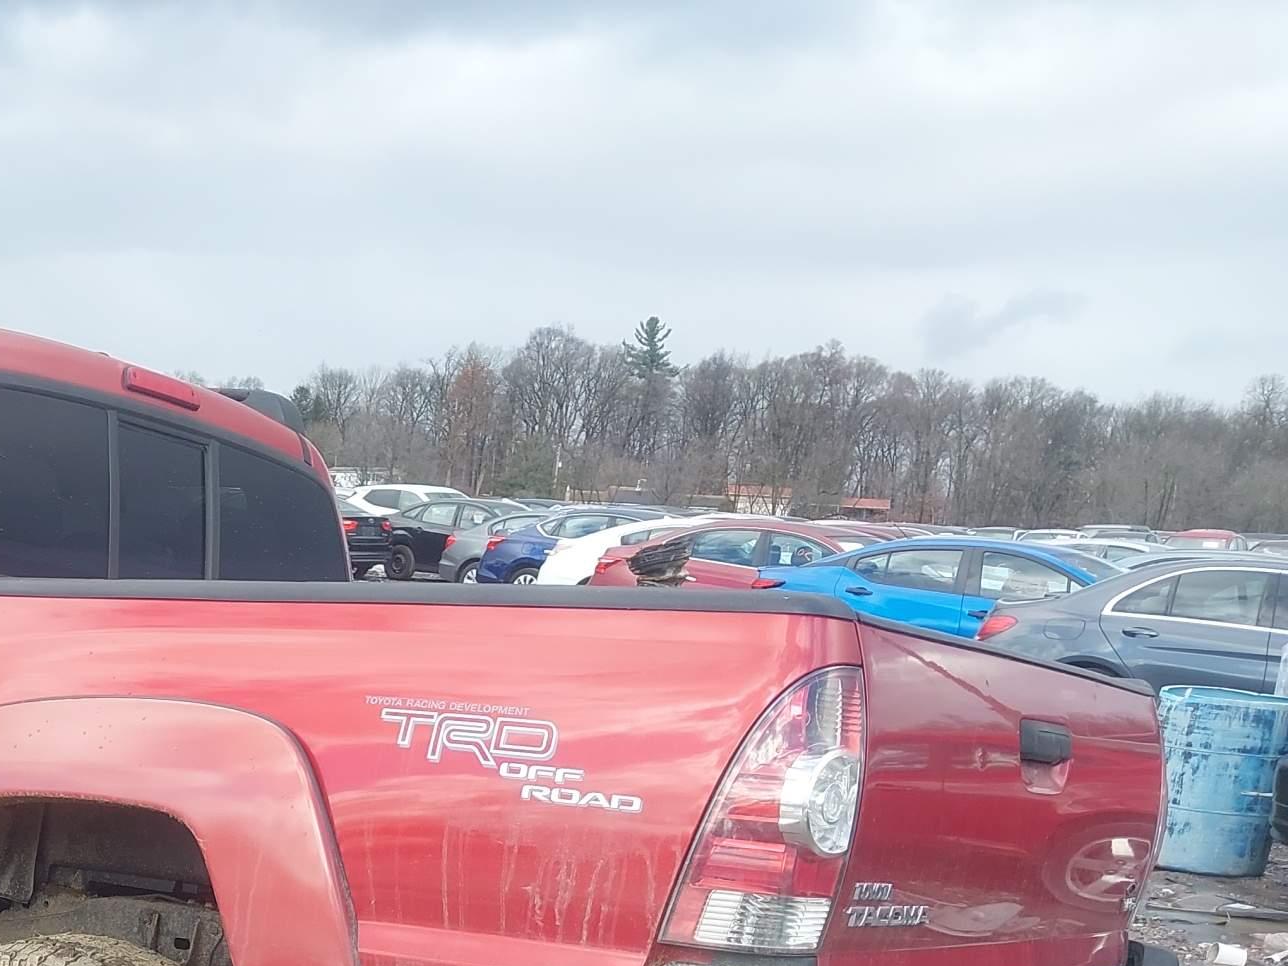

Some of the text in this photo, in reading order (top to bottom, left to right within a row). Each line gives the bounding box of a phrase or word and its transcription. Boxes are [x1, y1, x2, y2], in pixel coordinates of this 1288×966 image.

[365, 695, 531, 717] TOYOTA RACING DEVELOPMENT
[381, 707, 559, 769] TRD
[498, 761, 586, 784] OFF
[519, 784, 643, 813] ROAD
[844, 905, 931, 928] TACOMA
